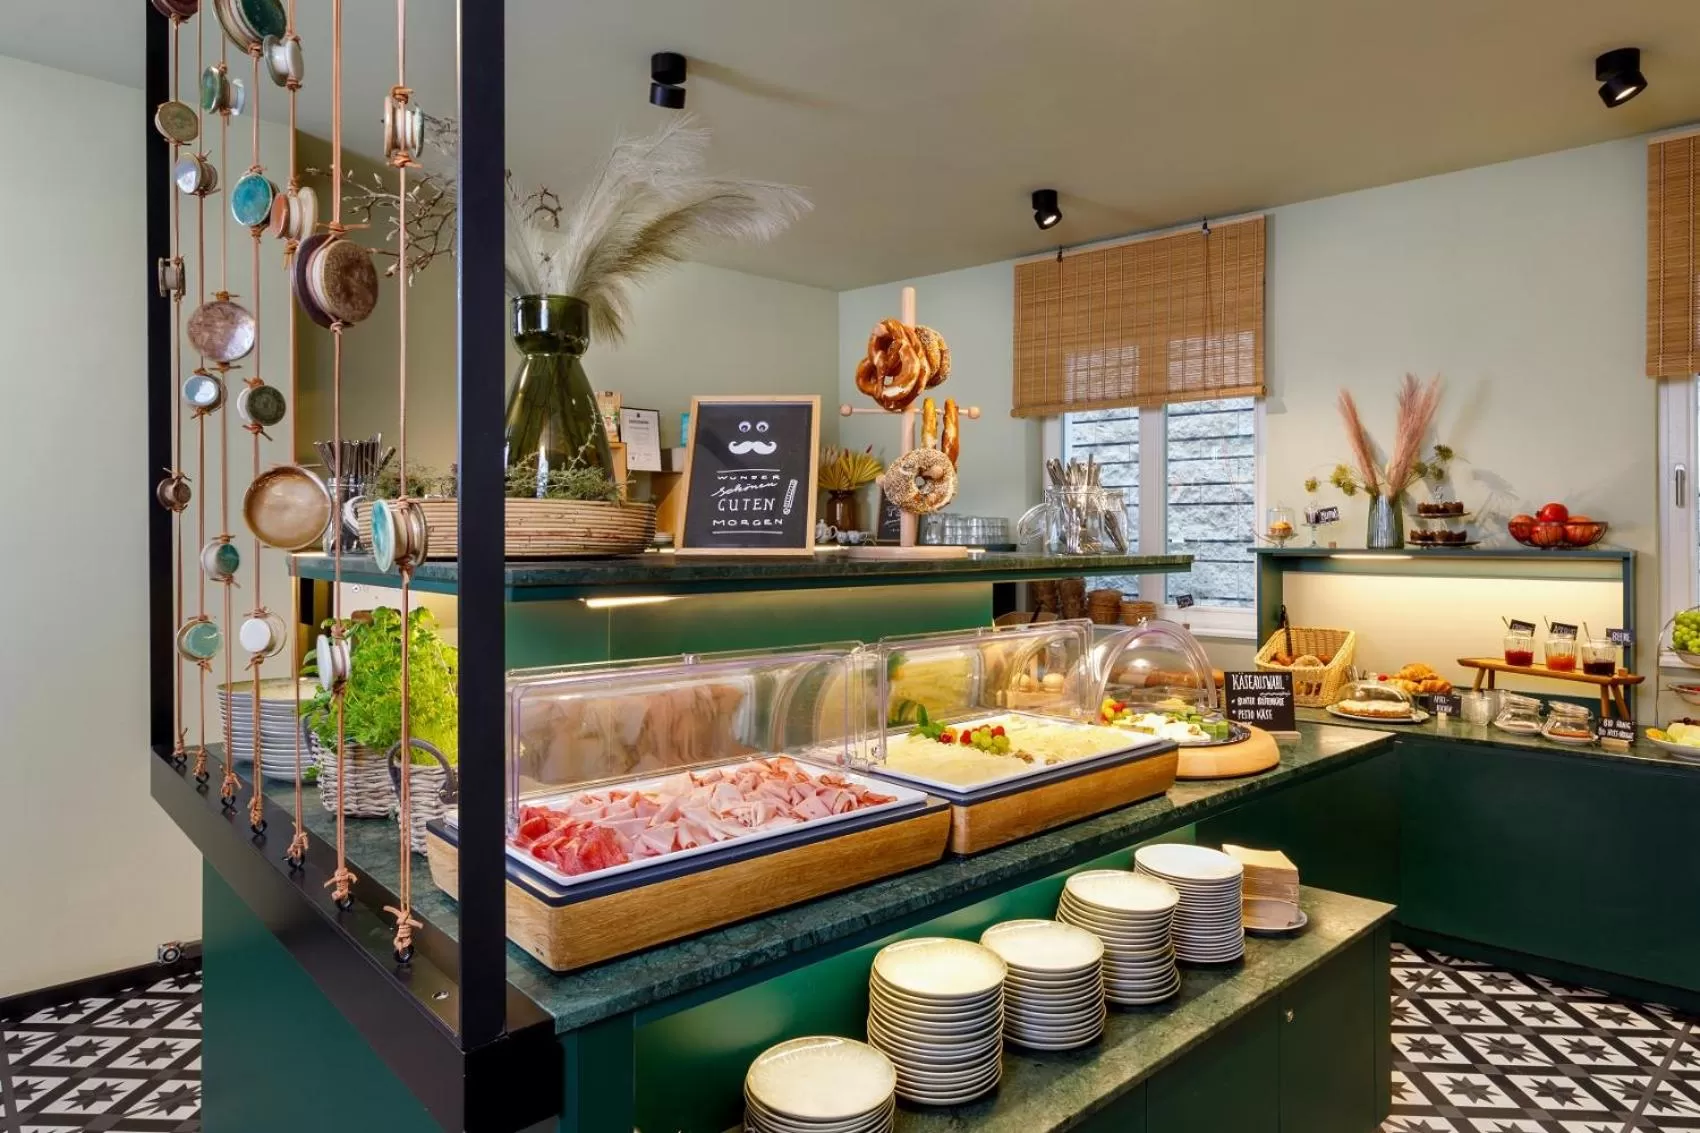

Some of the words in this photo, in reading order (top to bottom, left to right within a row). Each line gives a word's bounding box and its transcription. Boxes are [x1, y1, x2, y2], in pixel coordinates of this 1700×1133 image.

[717, 498, 776, 512] GUTEN
[712, 519, 783, 527] MORGEN
[1237, 709, 1255, 720] PESTO
[1256, 708, 1273, 720] KÄSE
